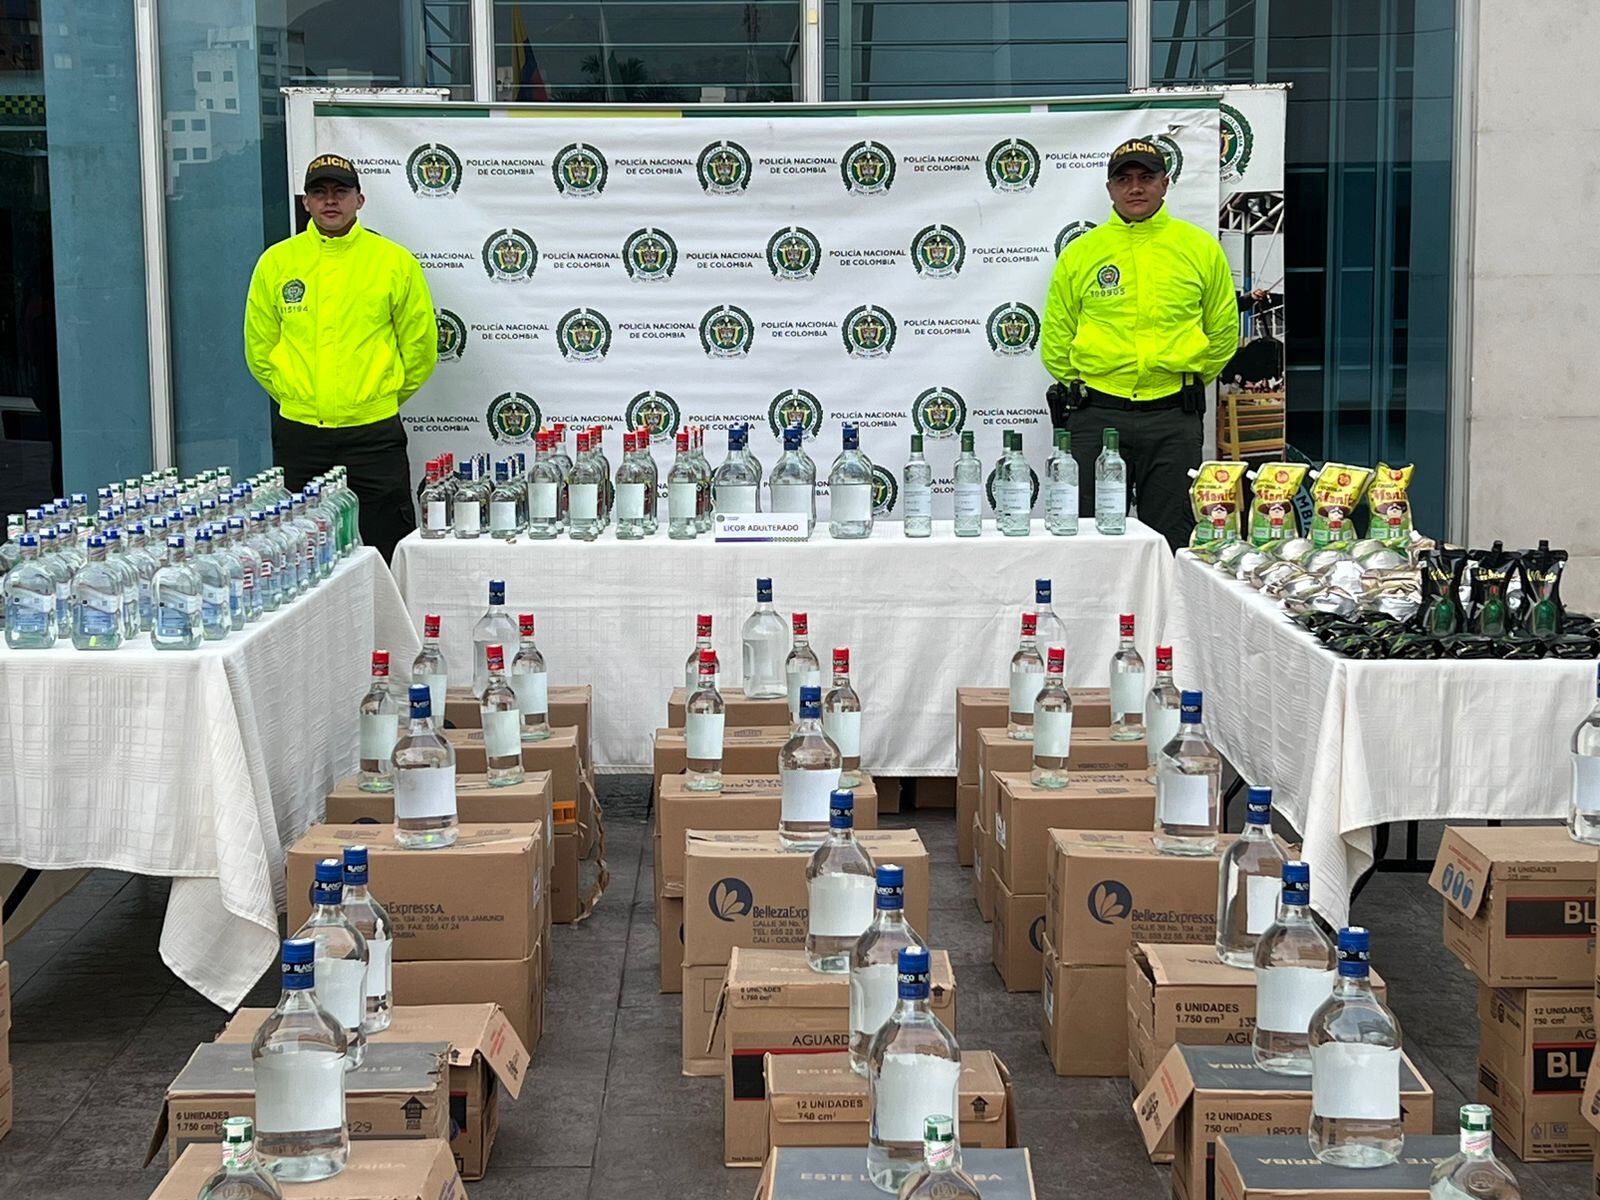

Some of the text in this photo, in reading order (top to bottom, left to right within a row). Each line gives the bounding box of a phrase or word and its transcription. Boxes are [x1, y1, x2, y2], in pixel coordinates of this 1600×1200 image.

[903, 154, 935, 163] POLICÍA
[1046, 152, 1078, 160] POLICÍA
[466, 158, 499, 166] POLICÍA
[615, 157, 647, 166] POLICÍA
[760, 156, 792, 165] POLICÍA
[626, 167, 636, 175] DE
[829, 249, 861, 257] POLICÍA
[972, 246, 1004, 254] POLICÍA
[542, 251, 575, 259] POLICÍA
[686, 251, 719, 259] POLICÍA
[618, 322, 651, 330] POLICÍA
[761, 320, 793, 328] POLICÍA
[904, 318, 936, 326] POLICÍA
[471, 322, 504, 331] POLICÍA
[831, 410, 863, 419] POLICÍA
[973, 408, 1005, 416] POLICÍA
[402, 415, 435, 423] POLICÍA
[546, 414, 579, 422] POLICÍA
[688, 413, 721, 422] POLICÍA
[724, 524, 798, 532] LICOR ADULTERADO
[1176, 1003, 1240, 1013] 6 UNIDADES
[1546, 1006, 1592, 1014] UNIDADES
[1176, 1015, 1202, 1024] 1.750
[796, 1100, 864, 1109] 12 UNIDADES
[176, 1112, 230, 1120] 6 UNIDADES
[1204, 1112, 1272, 1121] 12 UNIDADES
[1204, 1124, 1221, 1132] 750
